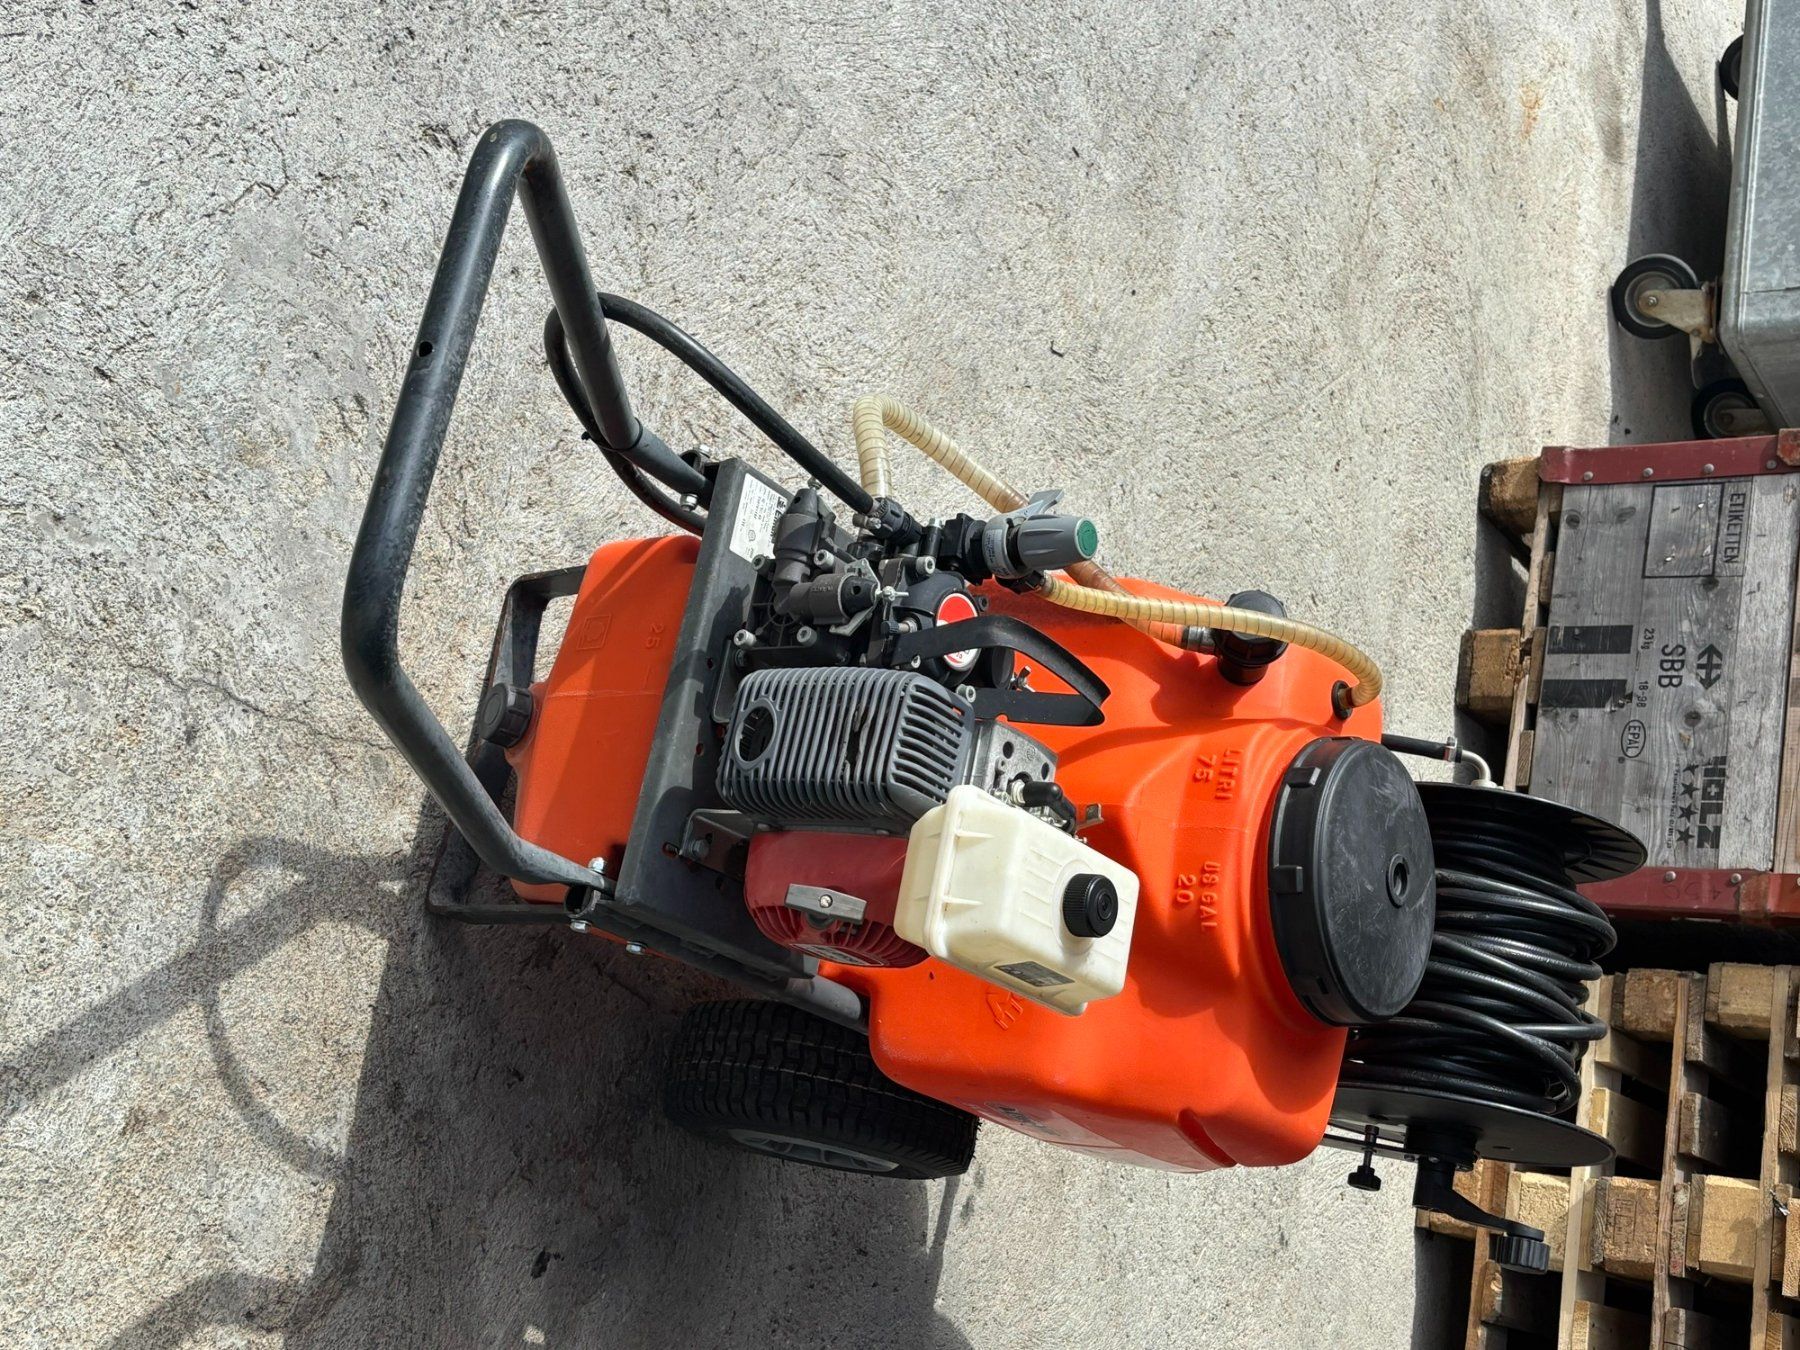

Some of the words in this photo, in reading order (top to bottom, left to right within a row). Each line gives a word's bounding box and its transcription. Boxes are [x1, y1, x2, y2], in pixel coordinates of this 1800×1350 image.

[1723, 492, 1747, 564] ETIKETTEN
[1658, 644, 1686, 688] SBB
[1627, 725, 1641, 752] EPAL
[1193, 754, 1216, 784] 75
[1214, 747, 1243, 801] LITRI
[1176, 873, 1198, 904] 20
[1200, 860, 1222, 887] US
[1200, 892, 1219, 930] GAL
